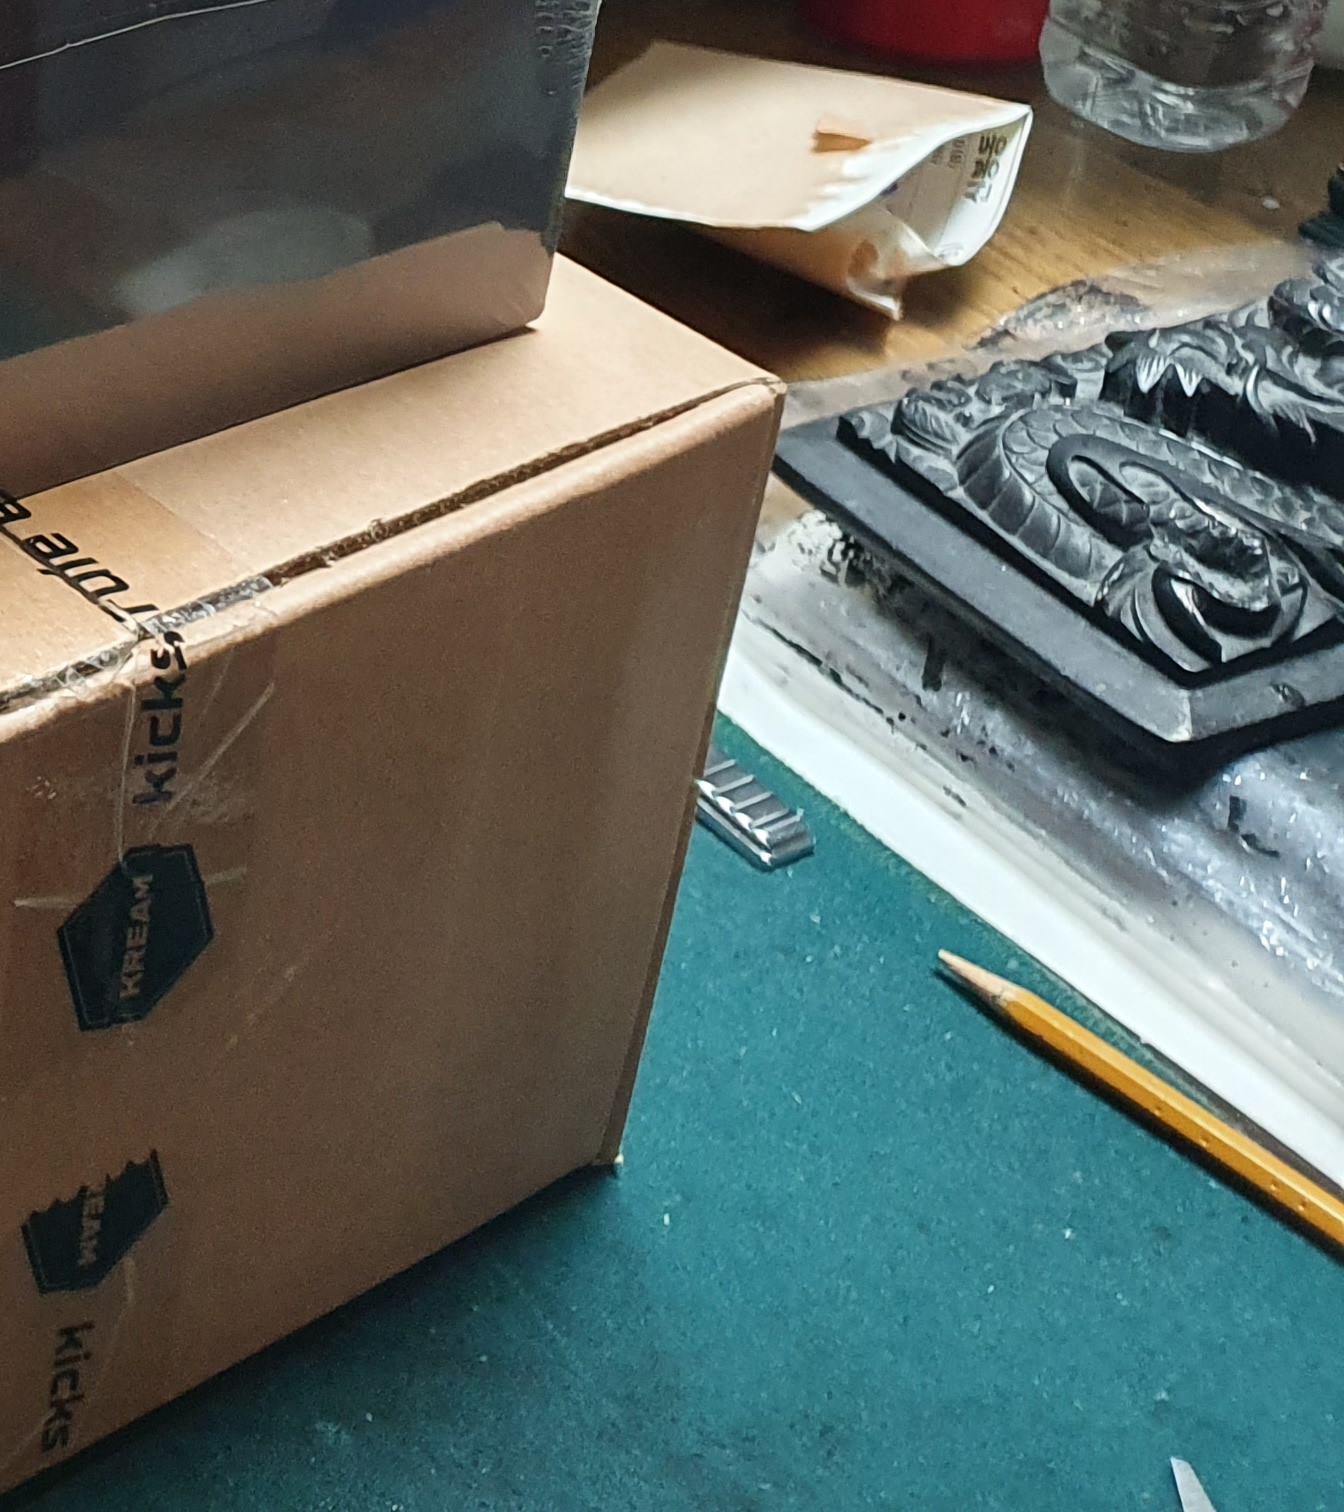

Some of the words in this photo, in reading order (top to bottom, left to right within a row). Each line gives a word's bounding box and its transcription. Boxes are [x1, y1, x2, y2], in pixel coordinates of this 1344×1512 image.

[20, 531, 160, 623] rule
[132, 631, 189, 806] kicks
[118, 874, 155, 1000] KREAM
[76, 1182, 108, 1270] EAM
[41, 1320, 96, 1454] kicks
